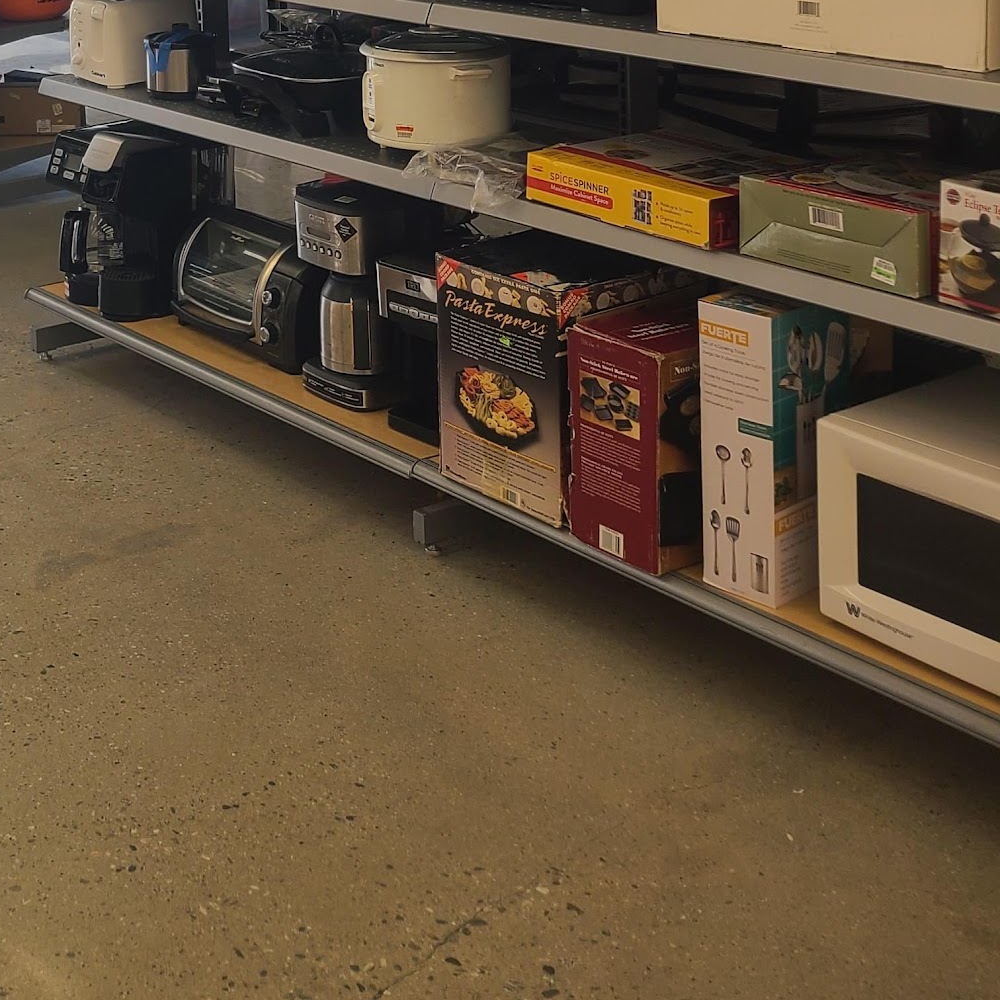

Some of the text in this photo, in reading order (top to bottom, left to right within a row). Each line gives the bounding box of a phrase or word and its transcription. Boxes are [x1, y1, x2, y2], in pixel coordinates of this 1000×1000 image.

[550, 183, 609, 206] Maximize Cabinet Space
[965, 198, 992, 213] Eclipse
[444, 289, 484, 316] Pasta
[483, 302, 549, 336] Express
[701, 323, 747, 345] FUERTE
